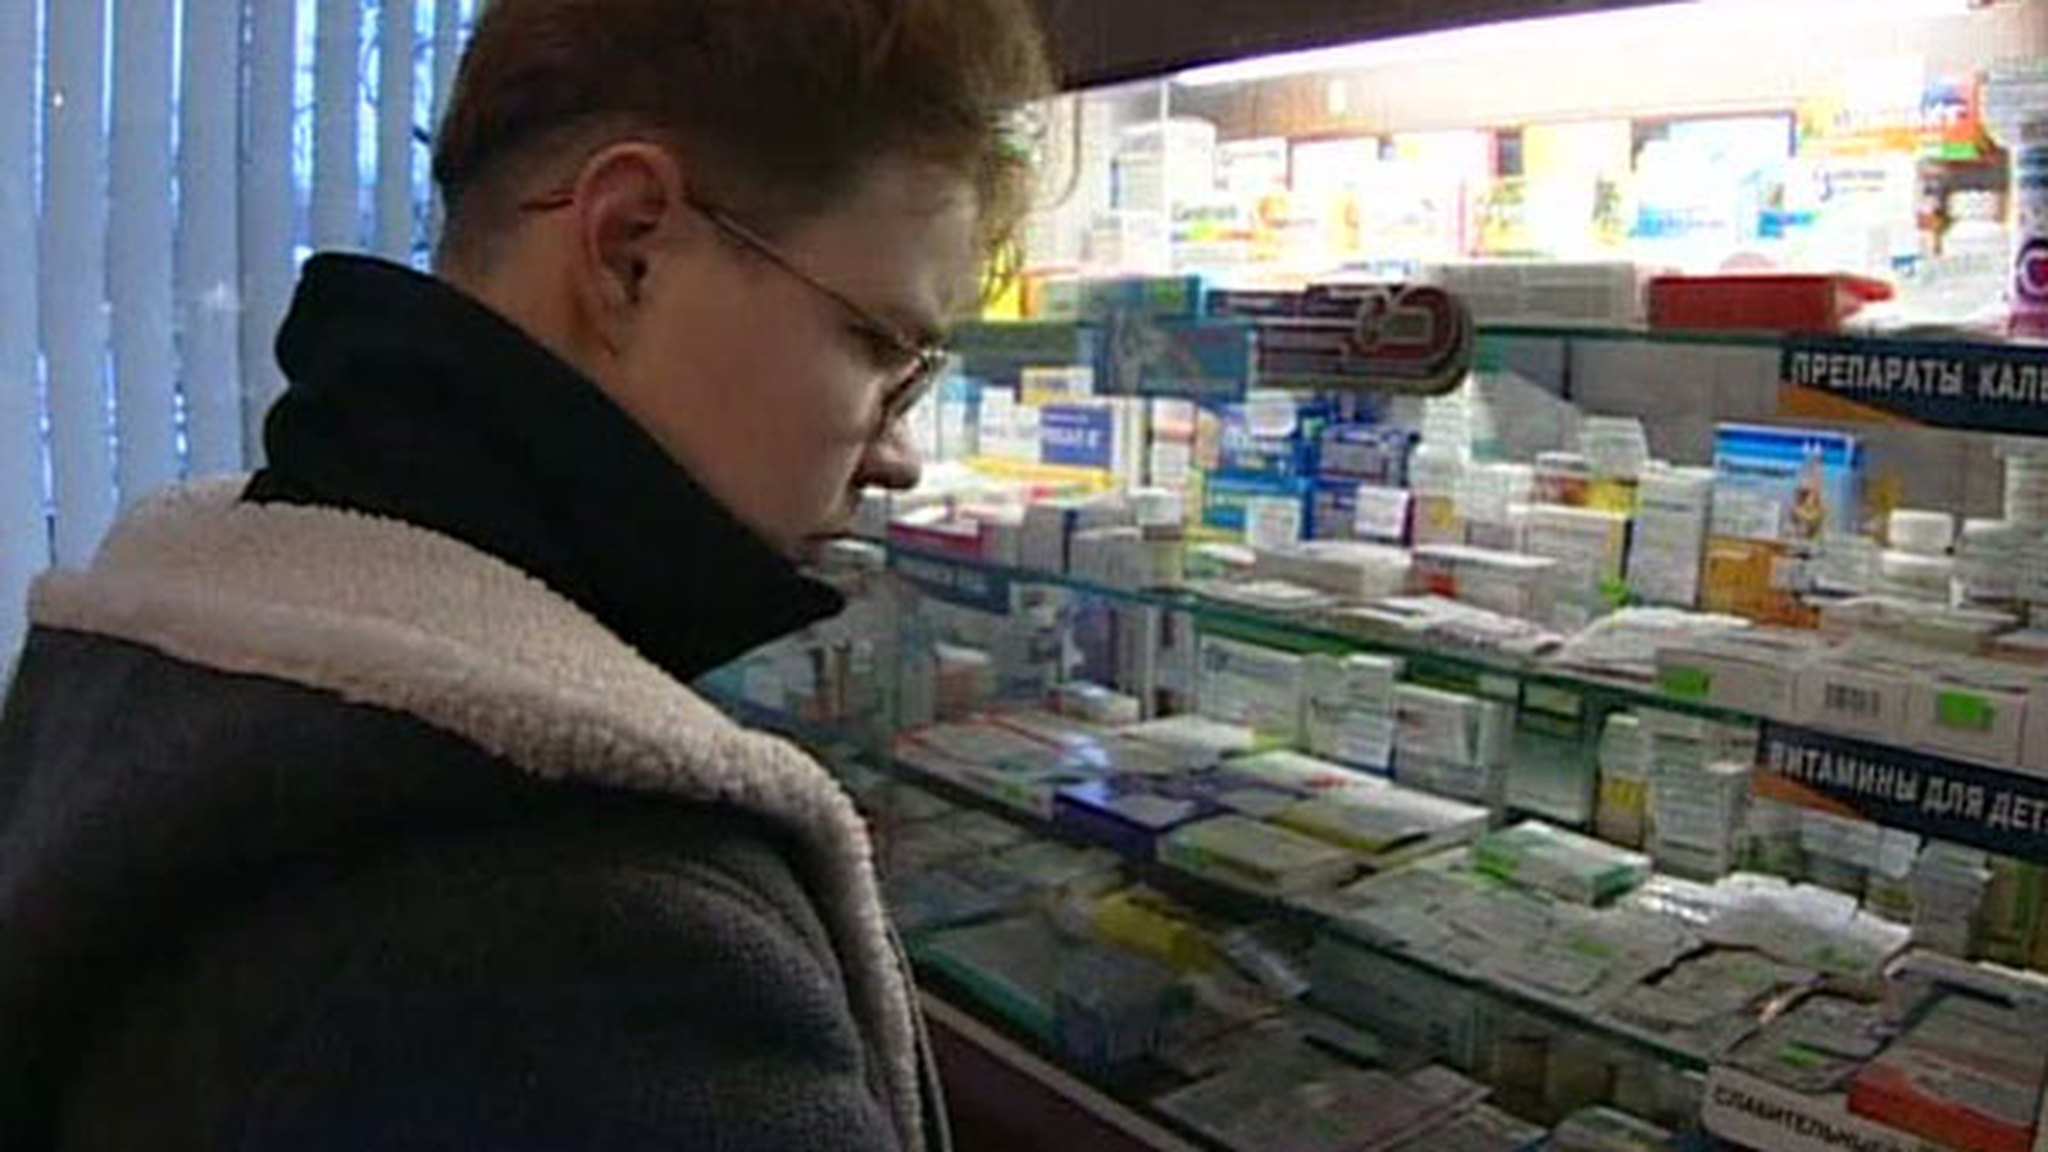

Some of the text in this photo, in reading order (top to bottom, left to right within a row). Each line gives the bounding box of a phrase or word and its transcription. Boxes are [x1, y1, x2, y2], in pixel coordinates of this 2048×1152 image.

[1790, 351, 1964, 396] ПРЕПАРАТЫ
[1769, 740, 2048, 834] ВИТАМИНЫ ДЛЯ ДЕТ
